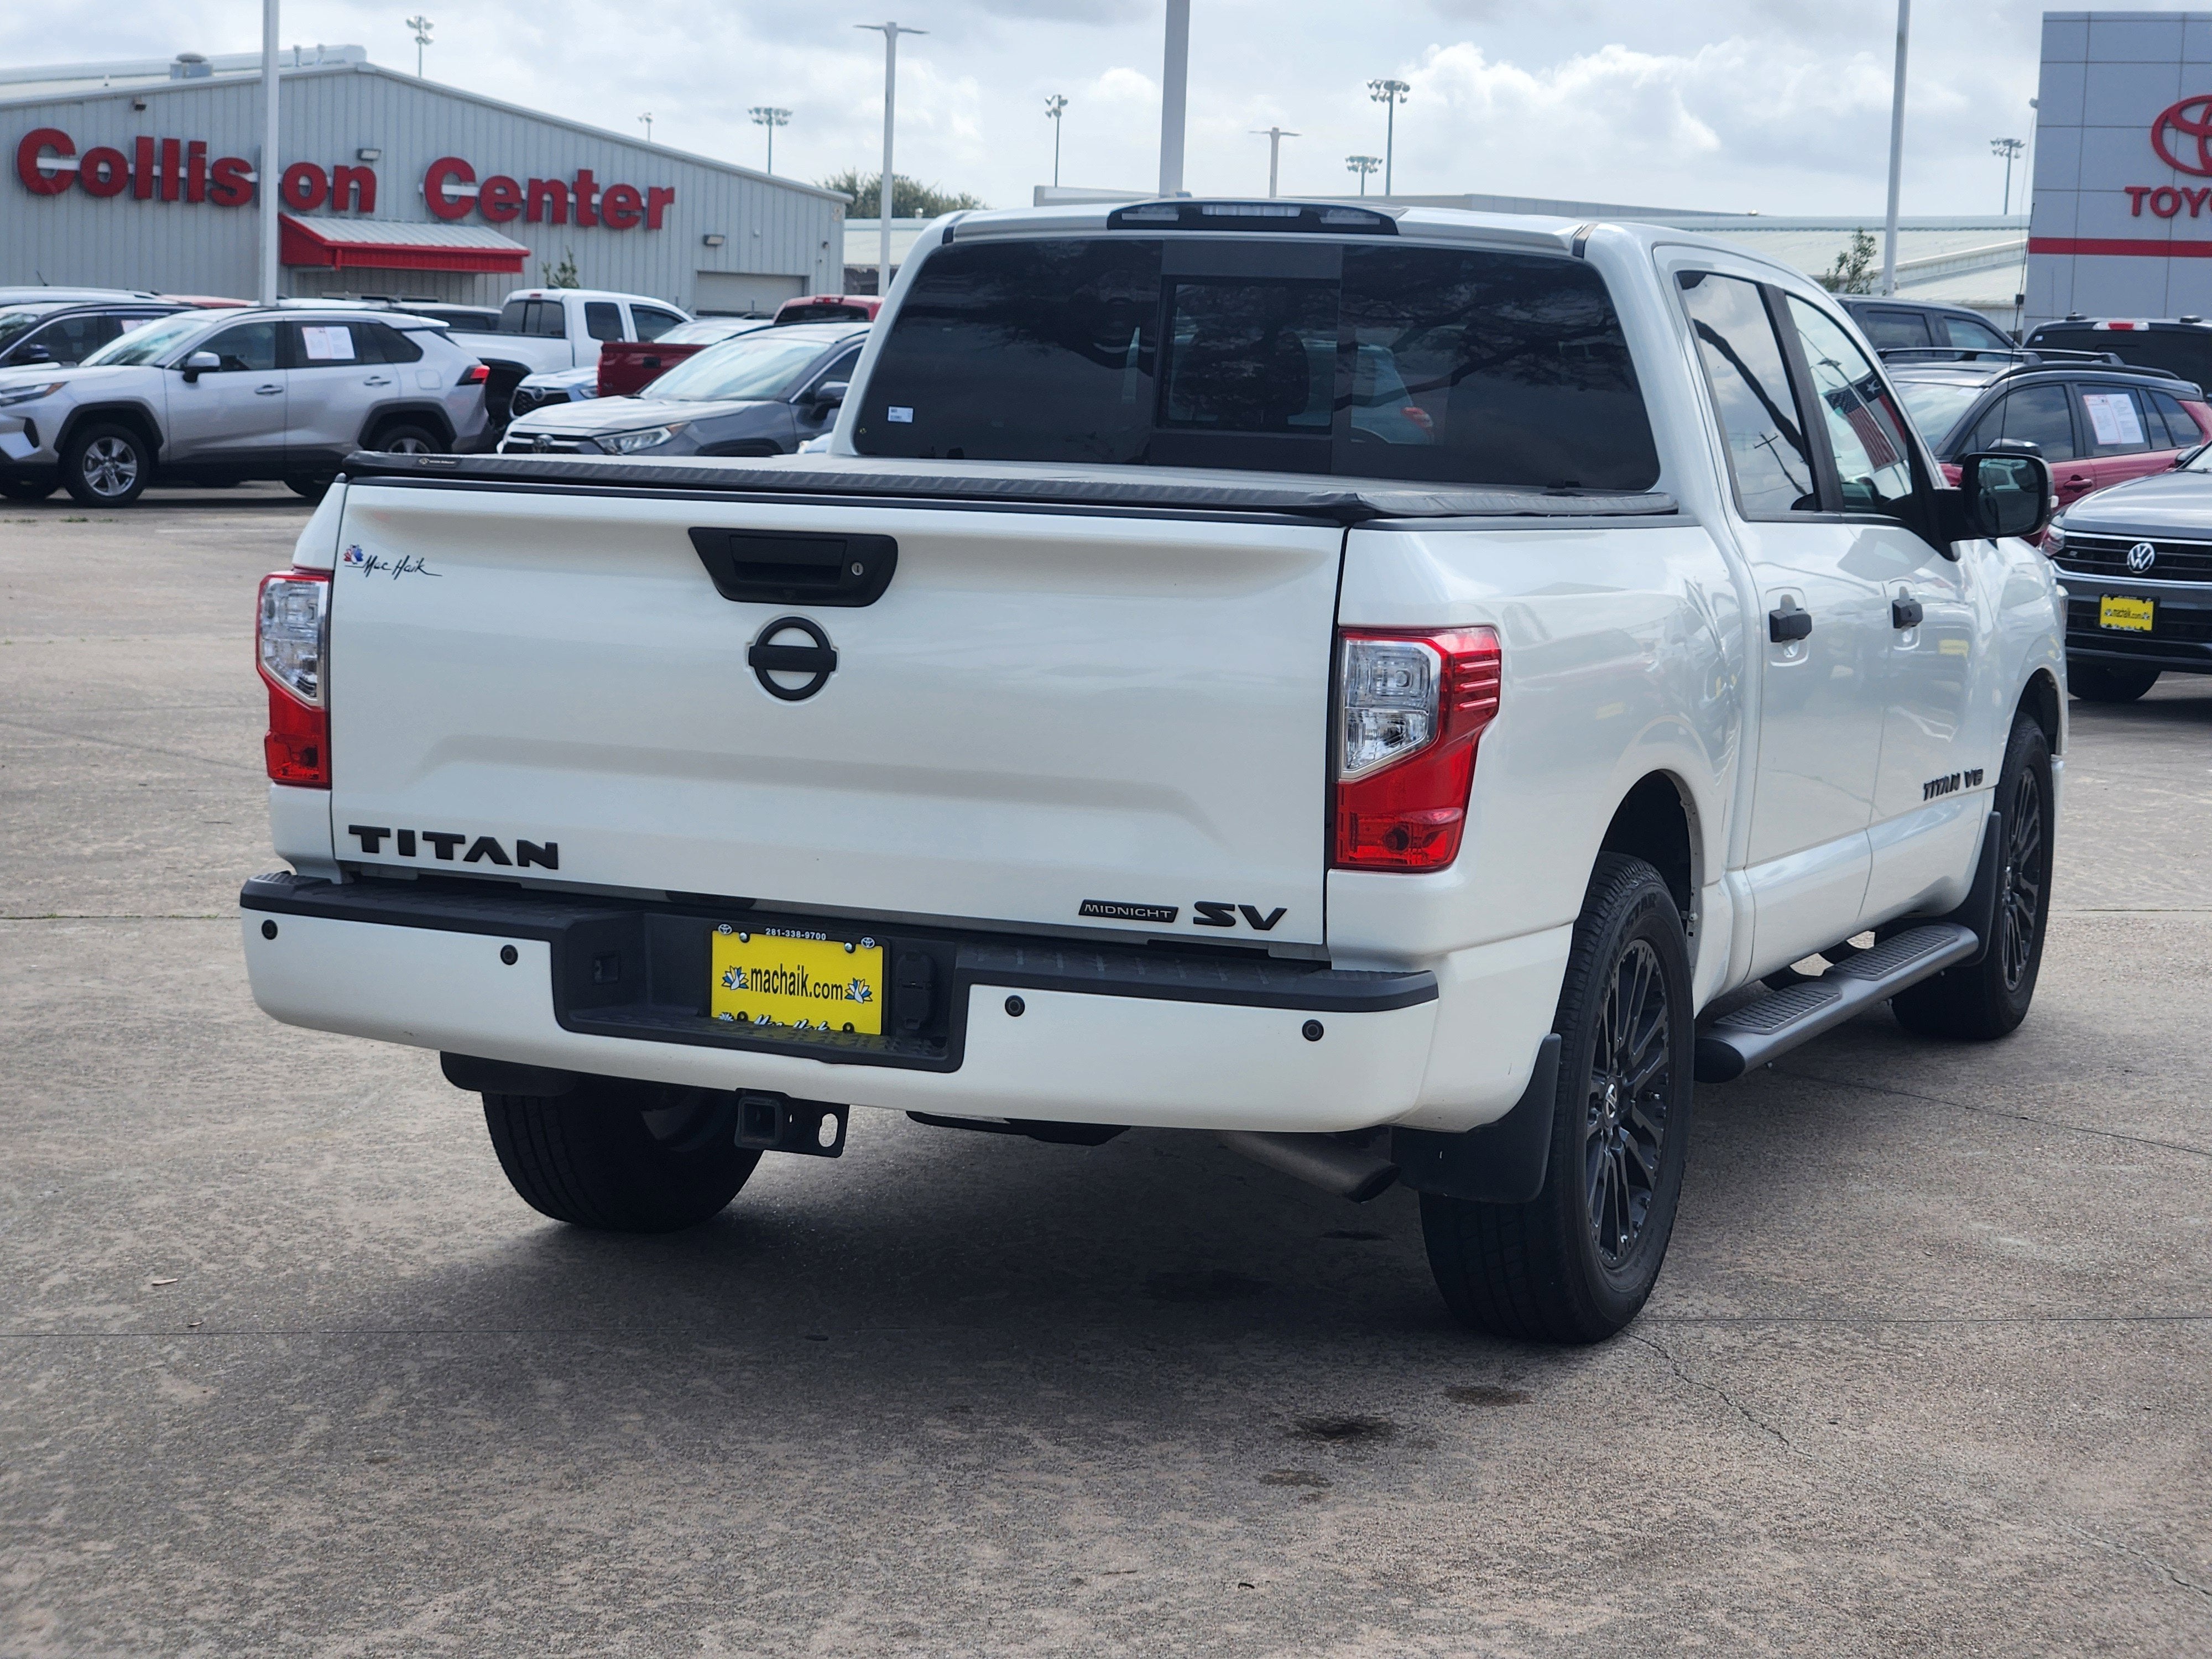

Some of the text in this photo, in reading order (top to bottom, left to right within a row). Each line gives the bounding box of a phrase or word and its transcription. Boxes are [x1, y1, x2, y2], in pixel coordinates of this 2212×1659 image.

[17, 127, 675, 230] Collison Center
[2125, 186, 2212, 218] TOY
[362, 555, 442, 580] Mac Haik
[1923, 767, 1984, 801] TITAN V8
[348, 825, 559, 870] TITAN
[1084, 901, 1287, 931] MIDNIGHT SV
[765, 927, 826, 941] 281-338-9700
[750, 963, 843, 1001] machaik.com
